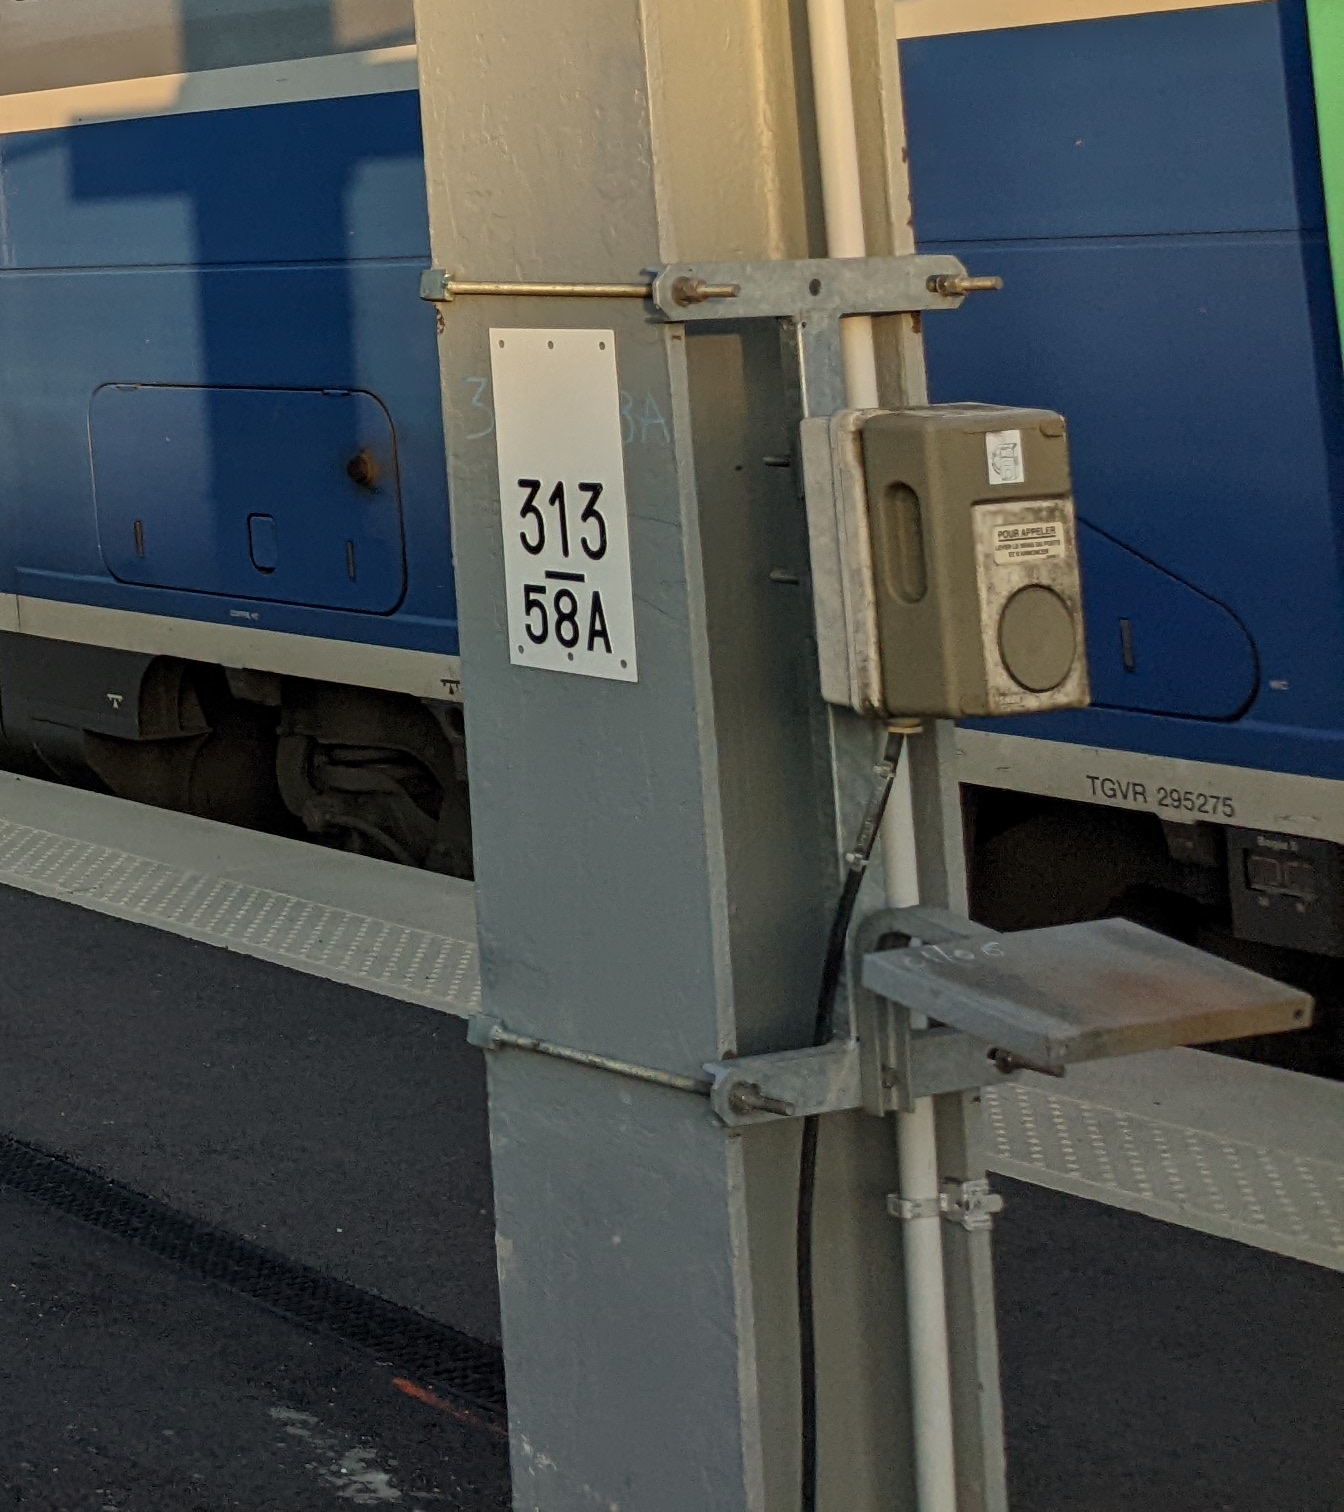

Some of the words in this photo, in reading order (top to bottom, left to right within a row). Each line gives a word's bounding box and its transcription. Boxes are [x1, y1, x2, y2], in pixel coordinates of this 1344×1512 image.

[517, 478, 608, 561] 313
[997, 528, 1020, 539] POUR
[1021, 525, 1056, 536] APPELER
[523, 583, 613, 654] 58A
[1086, 774, 1149, 805] TGVR
[1157, 786, 1236, 819] 295275
